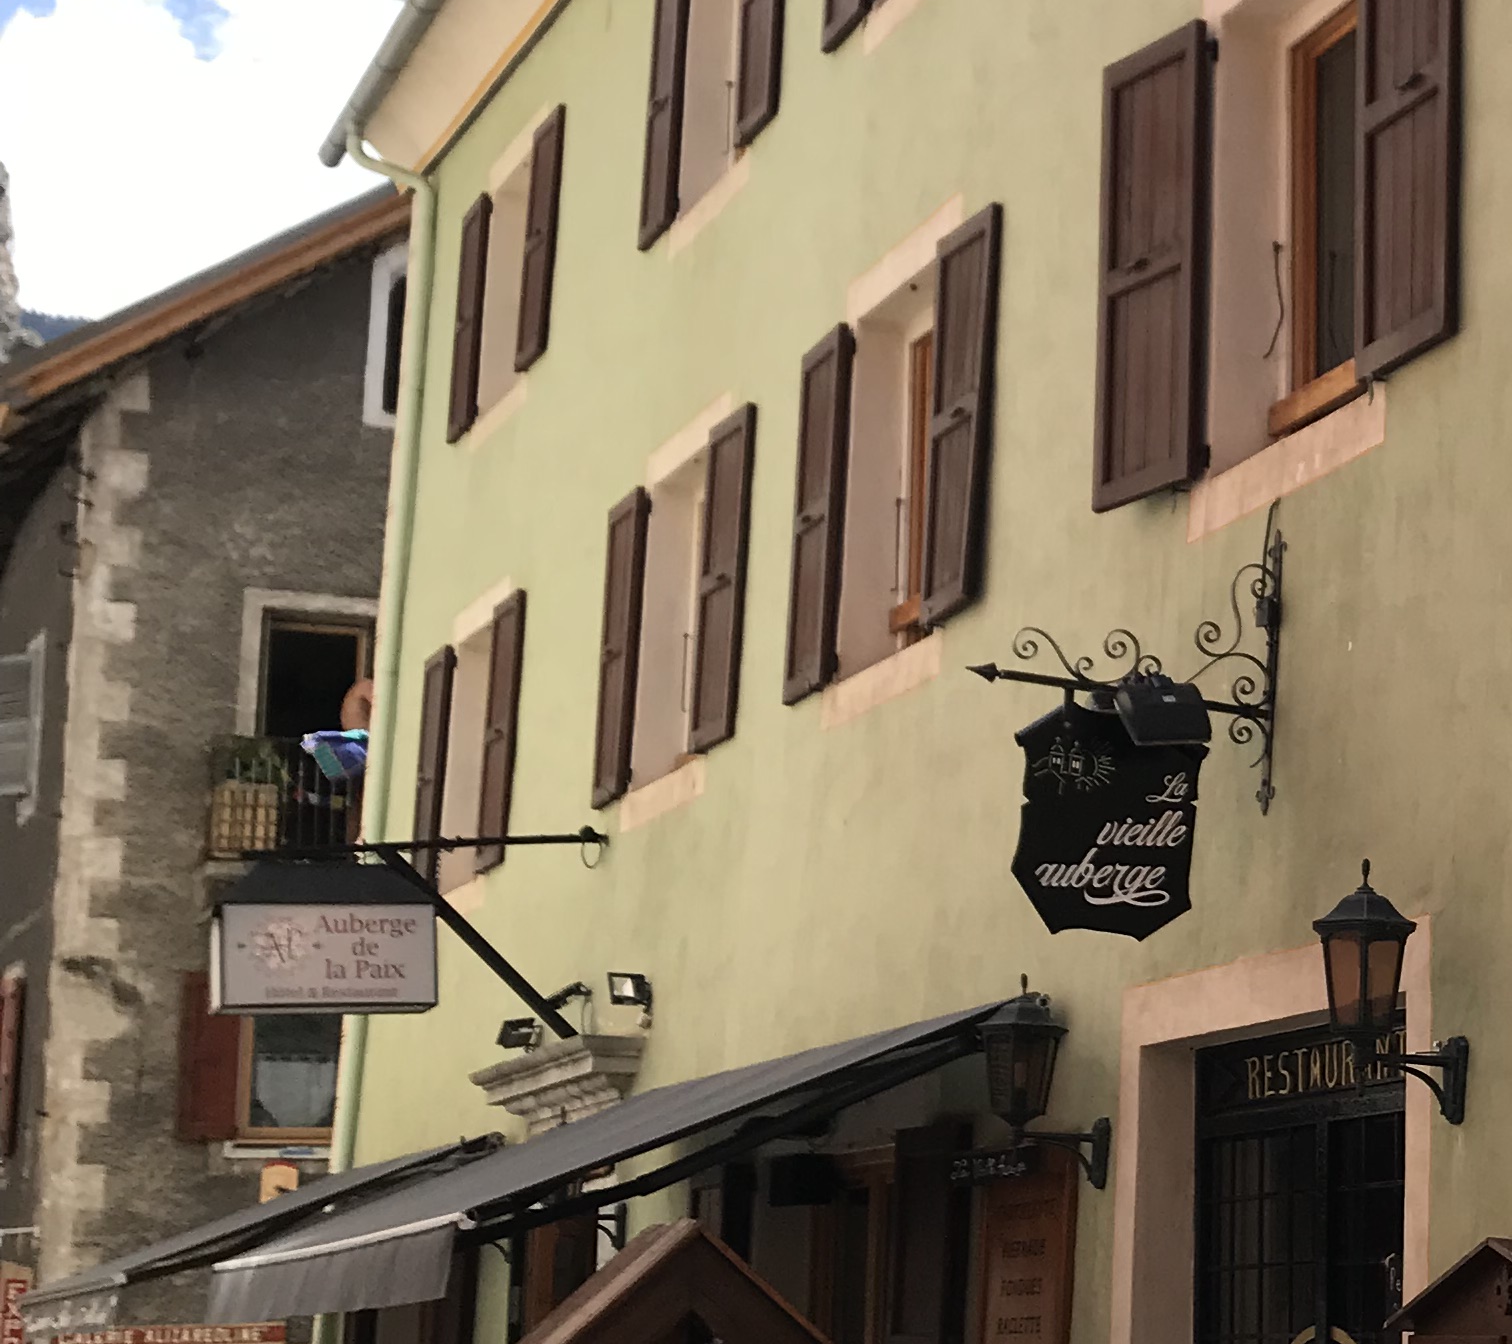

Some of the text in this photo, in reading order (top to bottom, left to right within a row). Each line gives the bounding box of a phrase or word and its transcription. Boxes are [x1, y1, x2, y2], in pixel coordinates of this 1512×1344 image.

[1145, 772, 1188, 803] La
[1096, 810, 1187, 847] vieille
[1035, 847, 1171, 907] auberge
[318, 913, 417, 939] Auberge
[351, 937, 380, 957] de
[325, 958, 406, 980] la Paix
[1244, 1030, 1407, 1100] RESTAURNT
